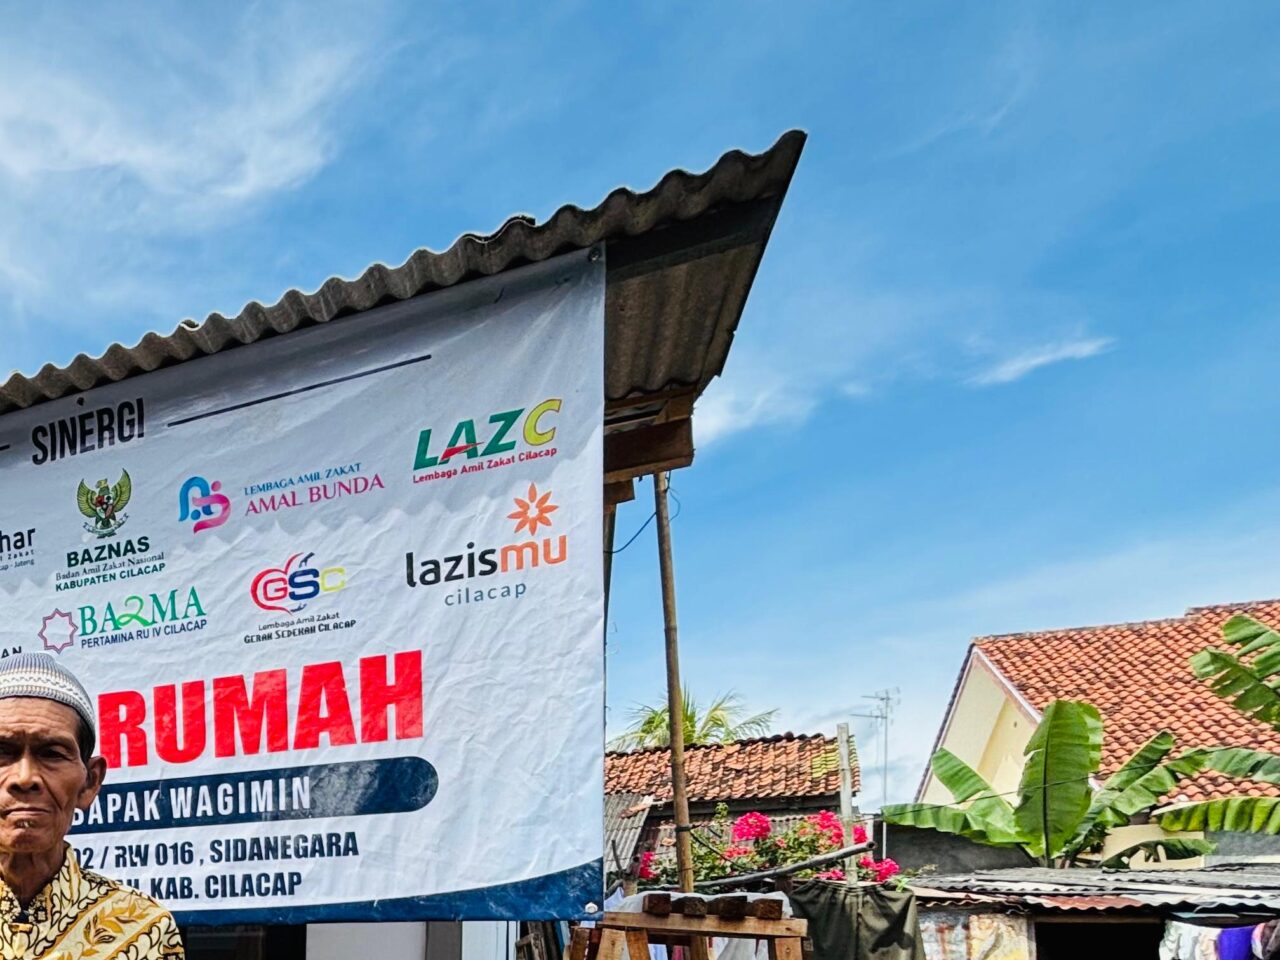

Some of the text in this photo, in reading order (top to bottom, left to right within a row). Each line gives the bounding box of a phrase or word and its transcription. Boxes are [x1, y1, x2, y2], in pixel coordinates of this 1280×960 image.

[31, 397, 144, 465] SINERGI
[413, 399, 562, 470] LAZC
[244, 462, 362, 496] LEMBAGA AMIL ZAKAT
[413, 447, 558, 484] Lembaga Amil Zakat Cilacap
[245, 473, 385, 516] AMAL BUNDA
[7, 549, 34, 560] Zakat
[55, 551, 165, 581] Badan Amil Zakat Nasional
[66, 536, 150, 568] BAZNAS
[405, 534, 568, 588] lazismu
[55, 562, 166, 592] KABUPATEN CILACAP
[444, 582, 527, 606] cilacap
[81, 618, 208, 649] PERTAMINA RU IV CILACAP
[258, 611, 340, 631] Lembaga Amil Zakat
[98, 650, 424, 769] RUMAH
[169, 776, 311, 819] WAGIMIN
[154, 841, 194, 866] 016
[209, 831, 359, 863] SIDANEGARA
[150, 876, 200, 900] KAB.
[205, 872, 303, 898] CILACAP
